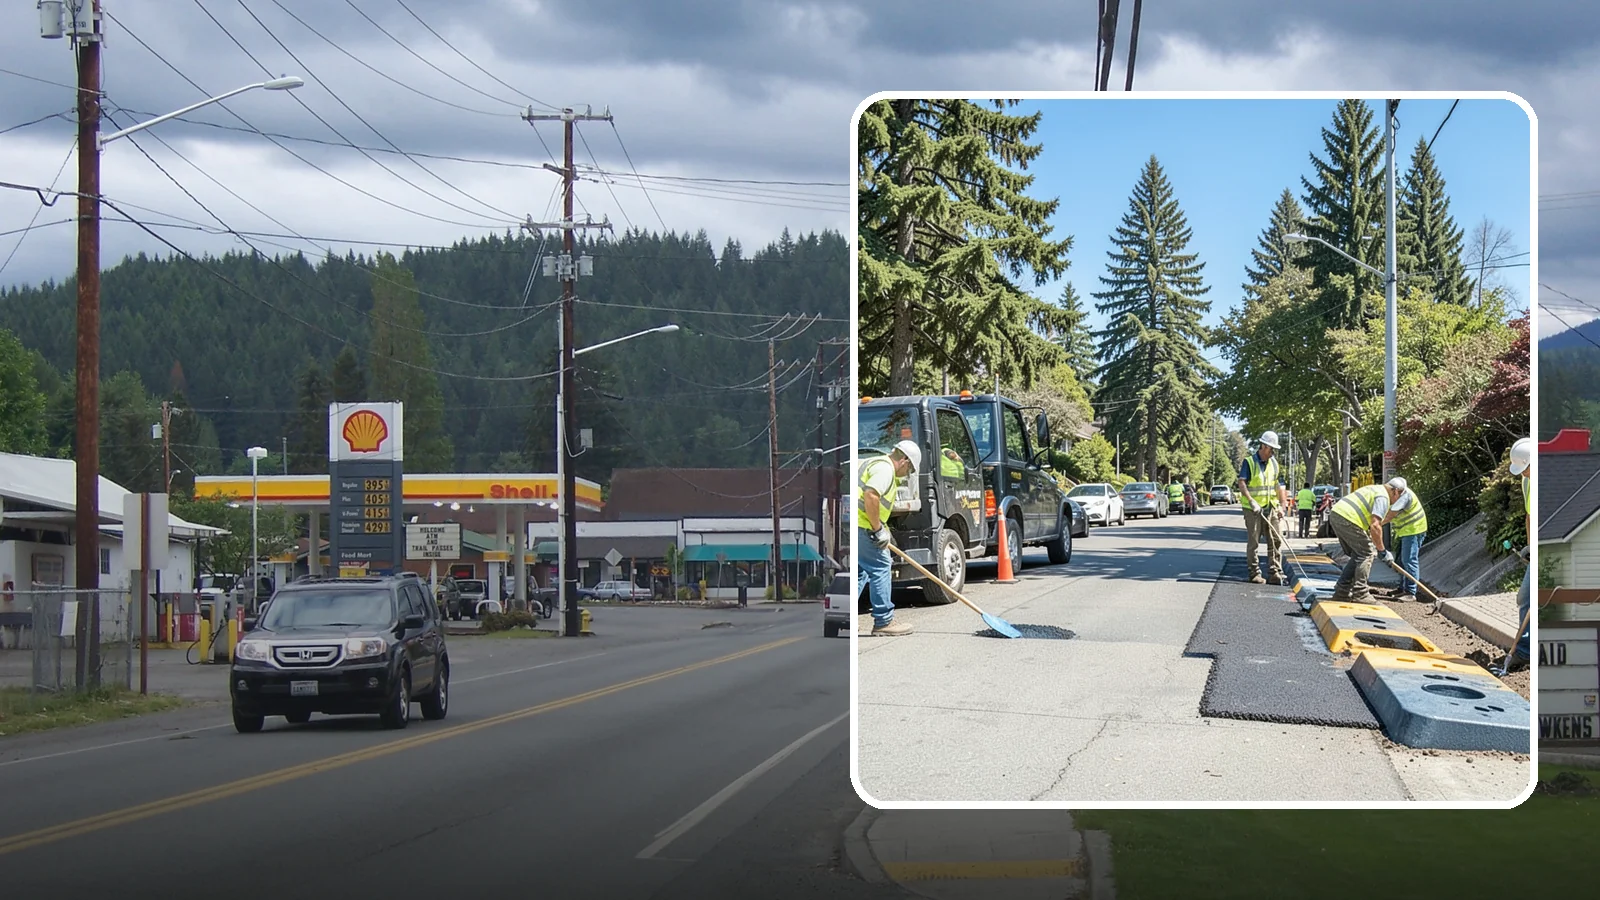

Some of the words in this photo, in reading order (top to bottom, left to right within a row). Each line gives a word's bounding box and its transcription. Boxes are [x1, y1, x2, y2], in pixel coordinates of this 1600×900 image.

[366, 480, 383, 490] 395
[490, 484, 547, 499] Shell
[366, 494, 383, 504] 405
[366, 508, 383, 518] 415
[366, 522, 383, 532] 429
